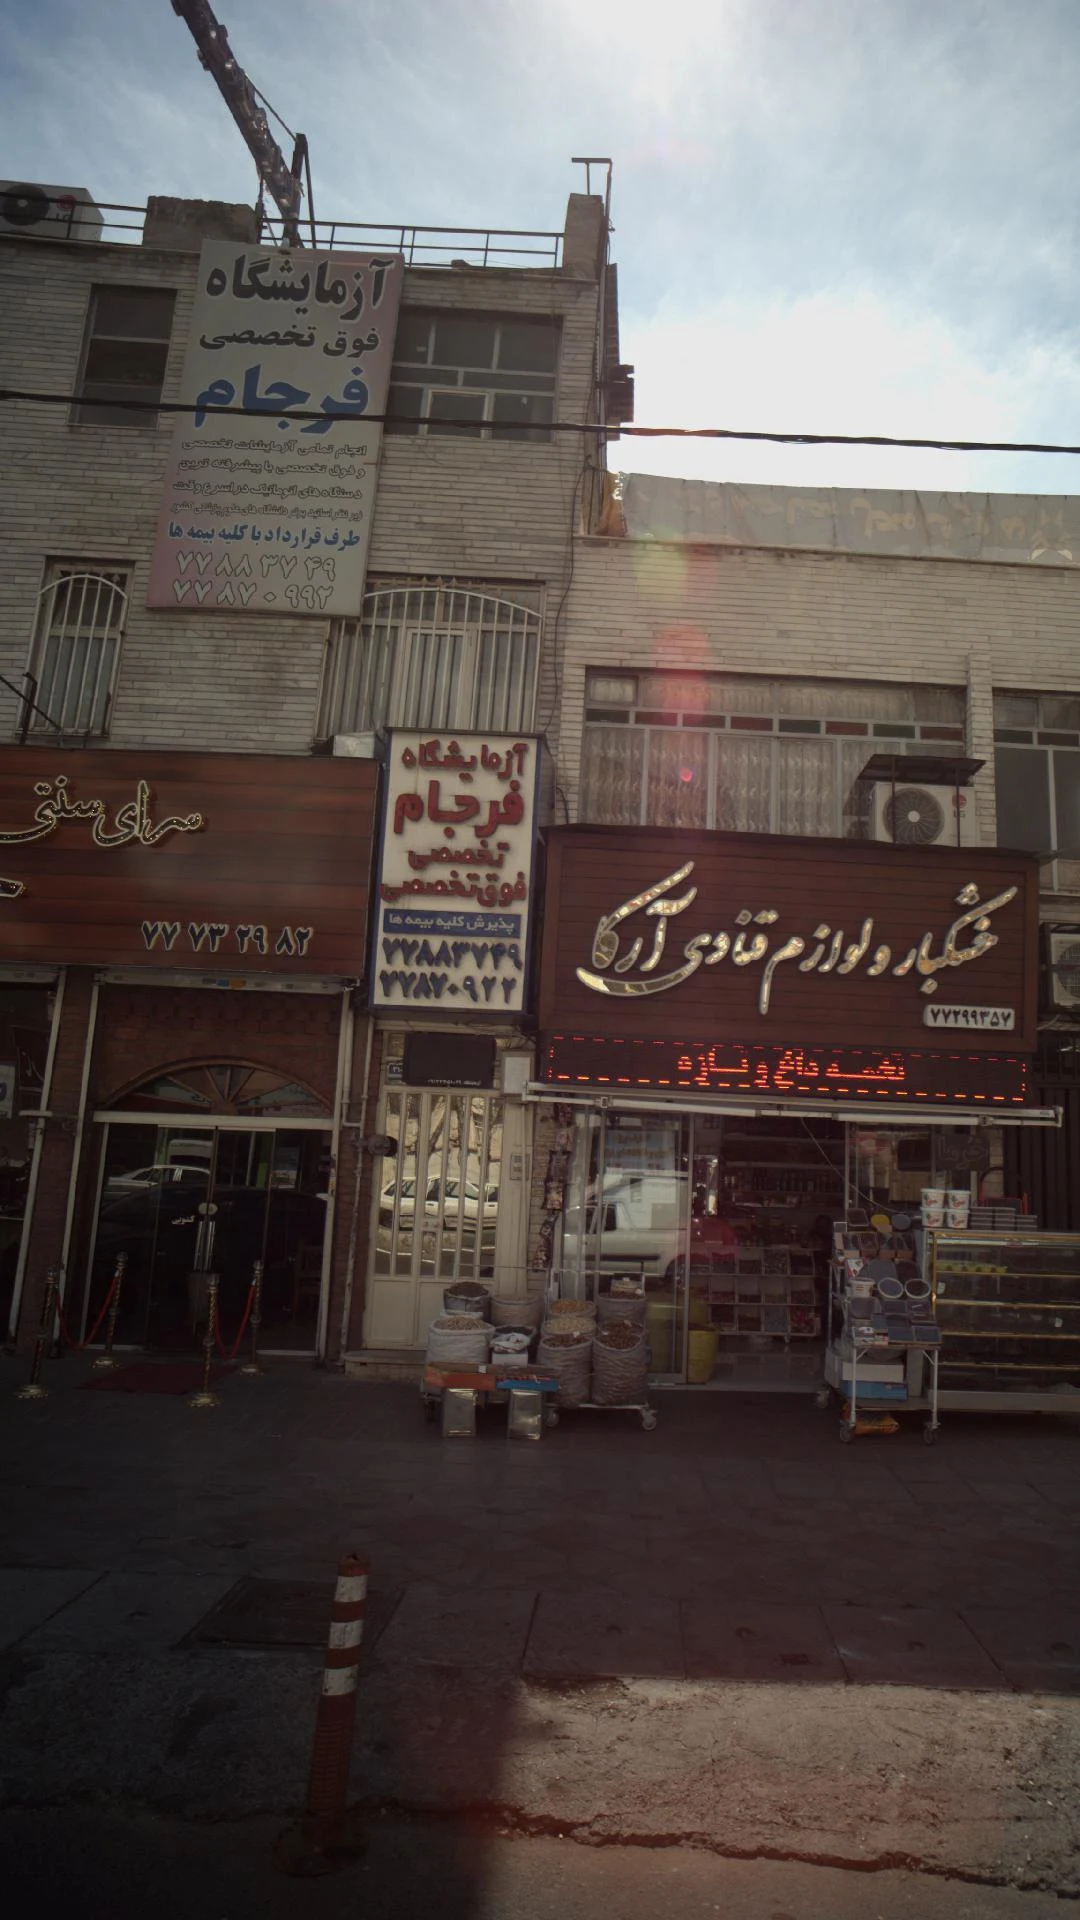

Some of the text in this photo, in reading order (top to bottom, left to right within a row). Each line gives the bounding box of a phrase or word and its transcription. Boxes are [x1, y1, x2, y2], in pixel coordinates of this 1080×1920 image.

[205, 254, 395, 321] آزمایشگاه
[199, 324, 380, 358] فوق تخصصی
[194, 363, 370, 434] فرجام
[182, 439, 367, 458] انجام تمامی آزمایشات تخصصی
[179, 459, 365, 479] و فوق تخصصی با پیشرفته ترین
[173, 480, 202, 494] وقت
[234, 485, 249, 496] در
[250, 484, 297, 499] اتوماتیک
[169, 519, 360, 551] طرف قرارداد با کلیه بیمه ها
[401, 739, 530, 783] آزمایشگاه
[0, 774, 203, 847] سرای سنتی
[393, 779, 526, 839] فرجام
[406, 839, 510, 870] تخصصی
[380, 870, 527, 907] فوق تخصصی
[389, 913, 515, 935] پذیرش کلیه بیمه ها
[892, 881, 1018, 995] خشکبار
[381, 936, 523, 971] ۷۷۸۸۳۷۴۹
[576, 908, 778, 997] قنادی
[759, 918, 874, 1015] لوازم
[867, 944, 891, 977] و
[379, 969, 517, 1004] ۷۷۸۷۰۹۲۲
[930, 1008, 1011, 1027] ۷۷۲۹۹۳۵۷
